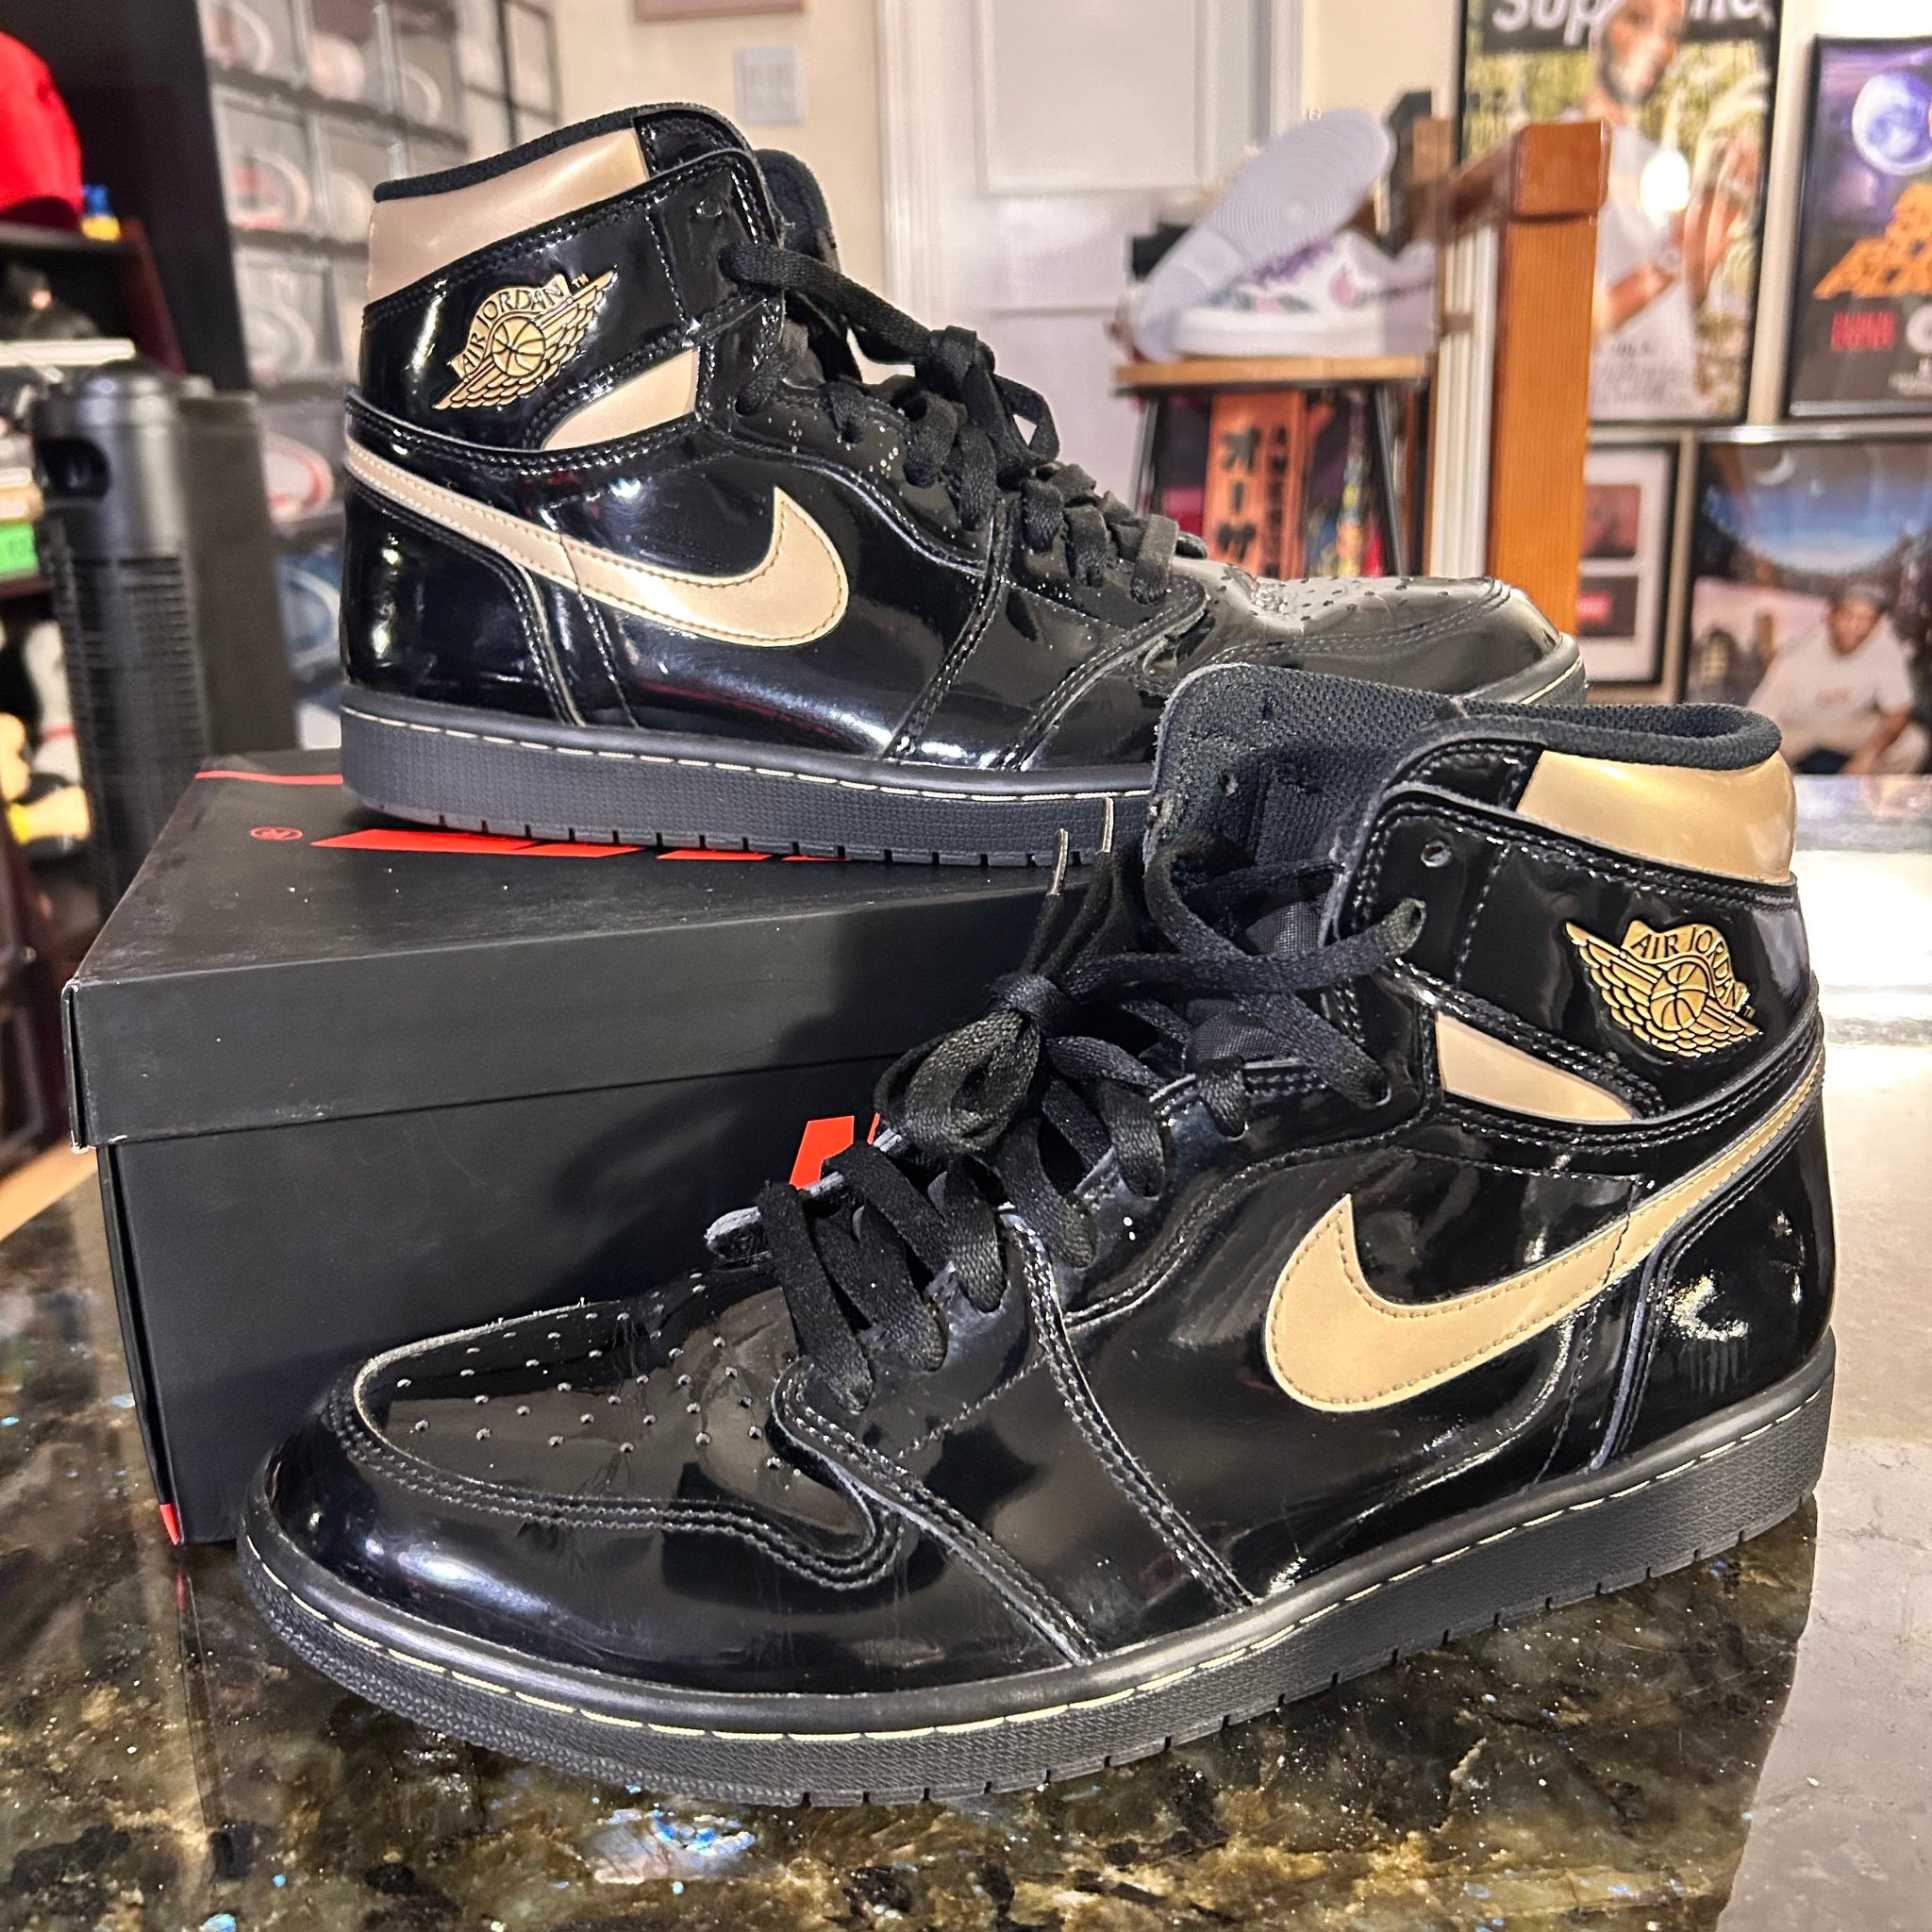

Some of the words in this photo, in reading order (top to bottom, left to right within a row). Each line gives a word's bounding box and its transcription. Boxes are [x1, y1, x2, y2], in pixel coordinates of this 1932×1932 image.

[462, 333, 485, 373] AIR
[477, 282, 563, 328] JORDAN
[1631, 935, 1677, 959] AIR
